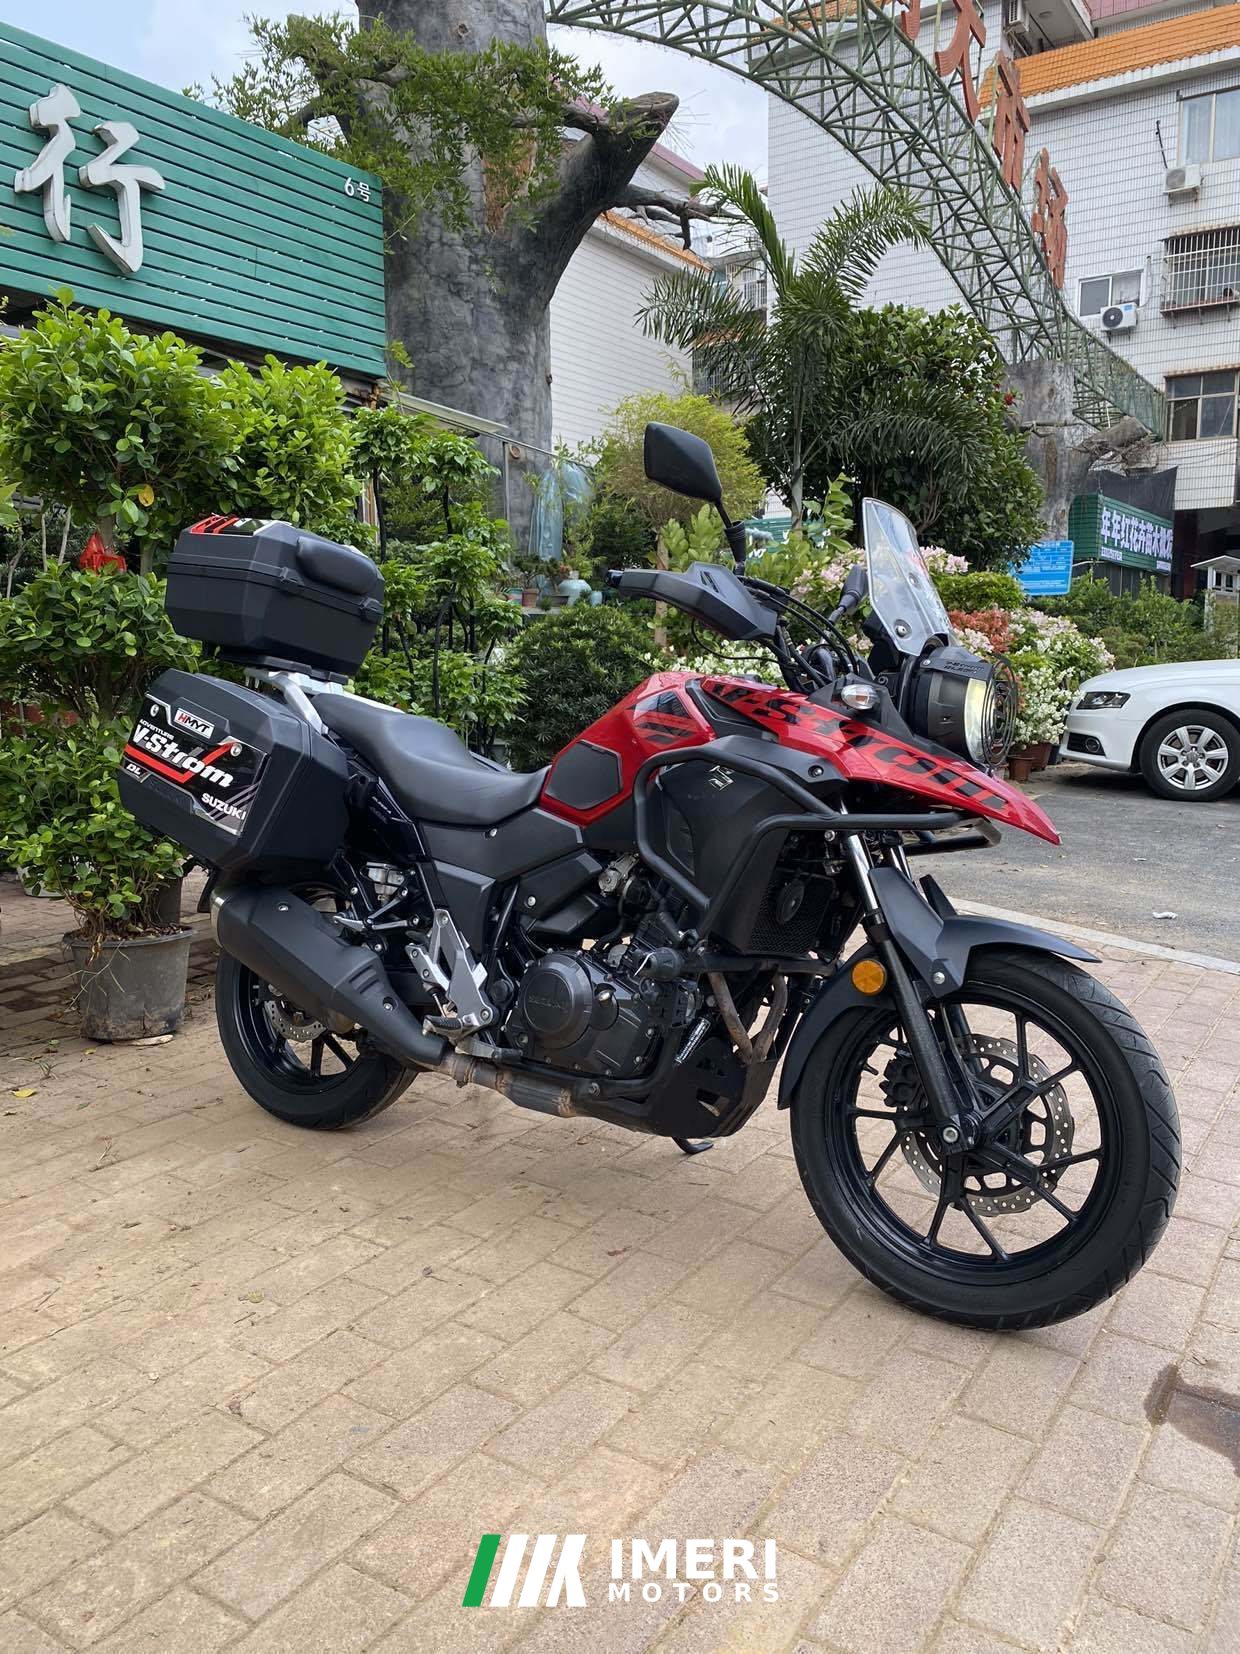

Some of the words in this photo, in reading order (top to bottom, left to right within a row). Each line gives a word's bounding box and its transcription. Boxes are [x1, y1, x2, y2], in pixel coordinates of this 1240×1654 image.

[344, 176, 372, 203] 6号
[177, 712, 211, 733] HMYT
[201, 792, 247, 820] SUZUKI
